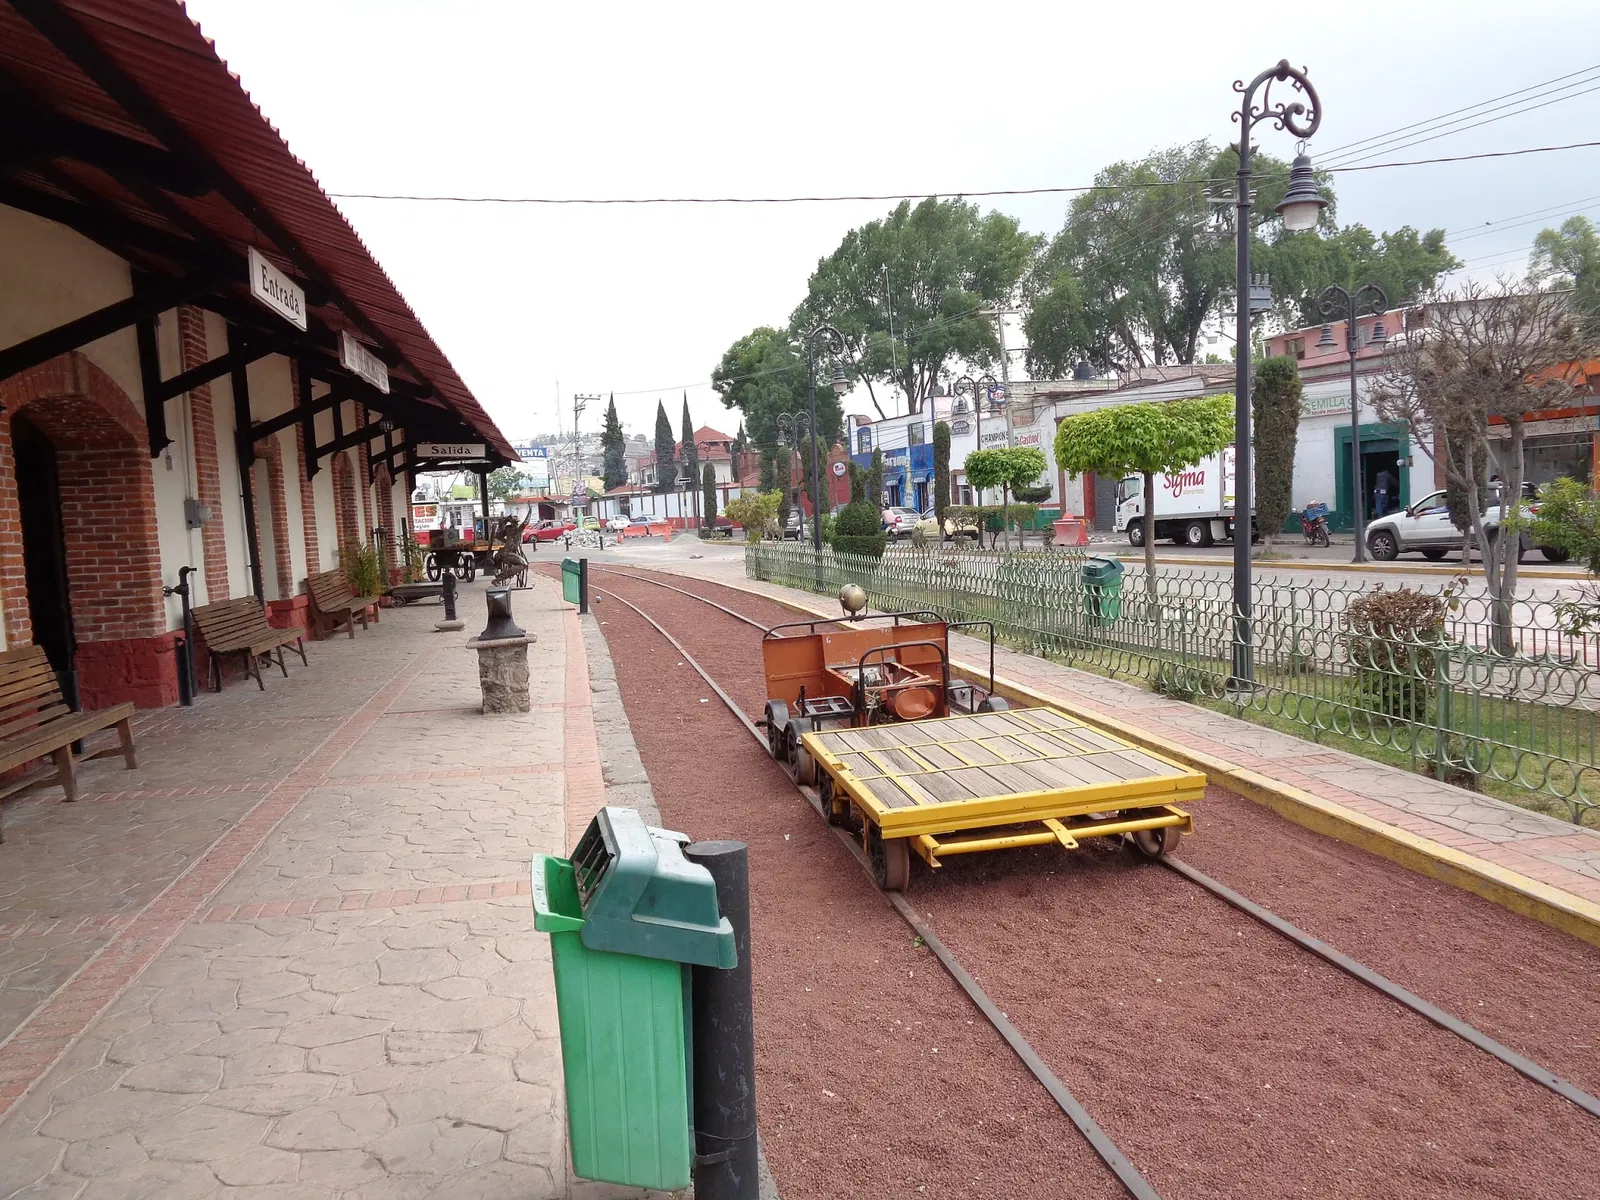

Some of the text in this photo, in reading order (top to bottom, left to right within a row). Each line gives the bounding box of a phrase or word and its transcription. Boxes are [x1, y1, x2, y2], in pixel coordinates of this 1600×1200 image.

[261, 263, 300, 316] Entrada
[1020, 433, 1039, 445] Castrol
[431, 445, 472, 455] Salida
[515, 449, 544, 457] VENTA
[1164, 470, 1205, 498] Sigma
